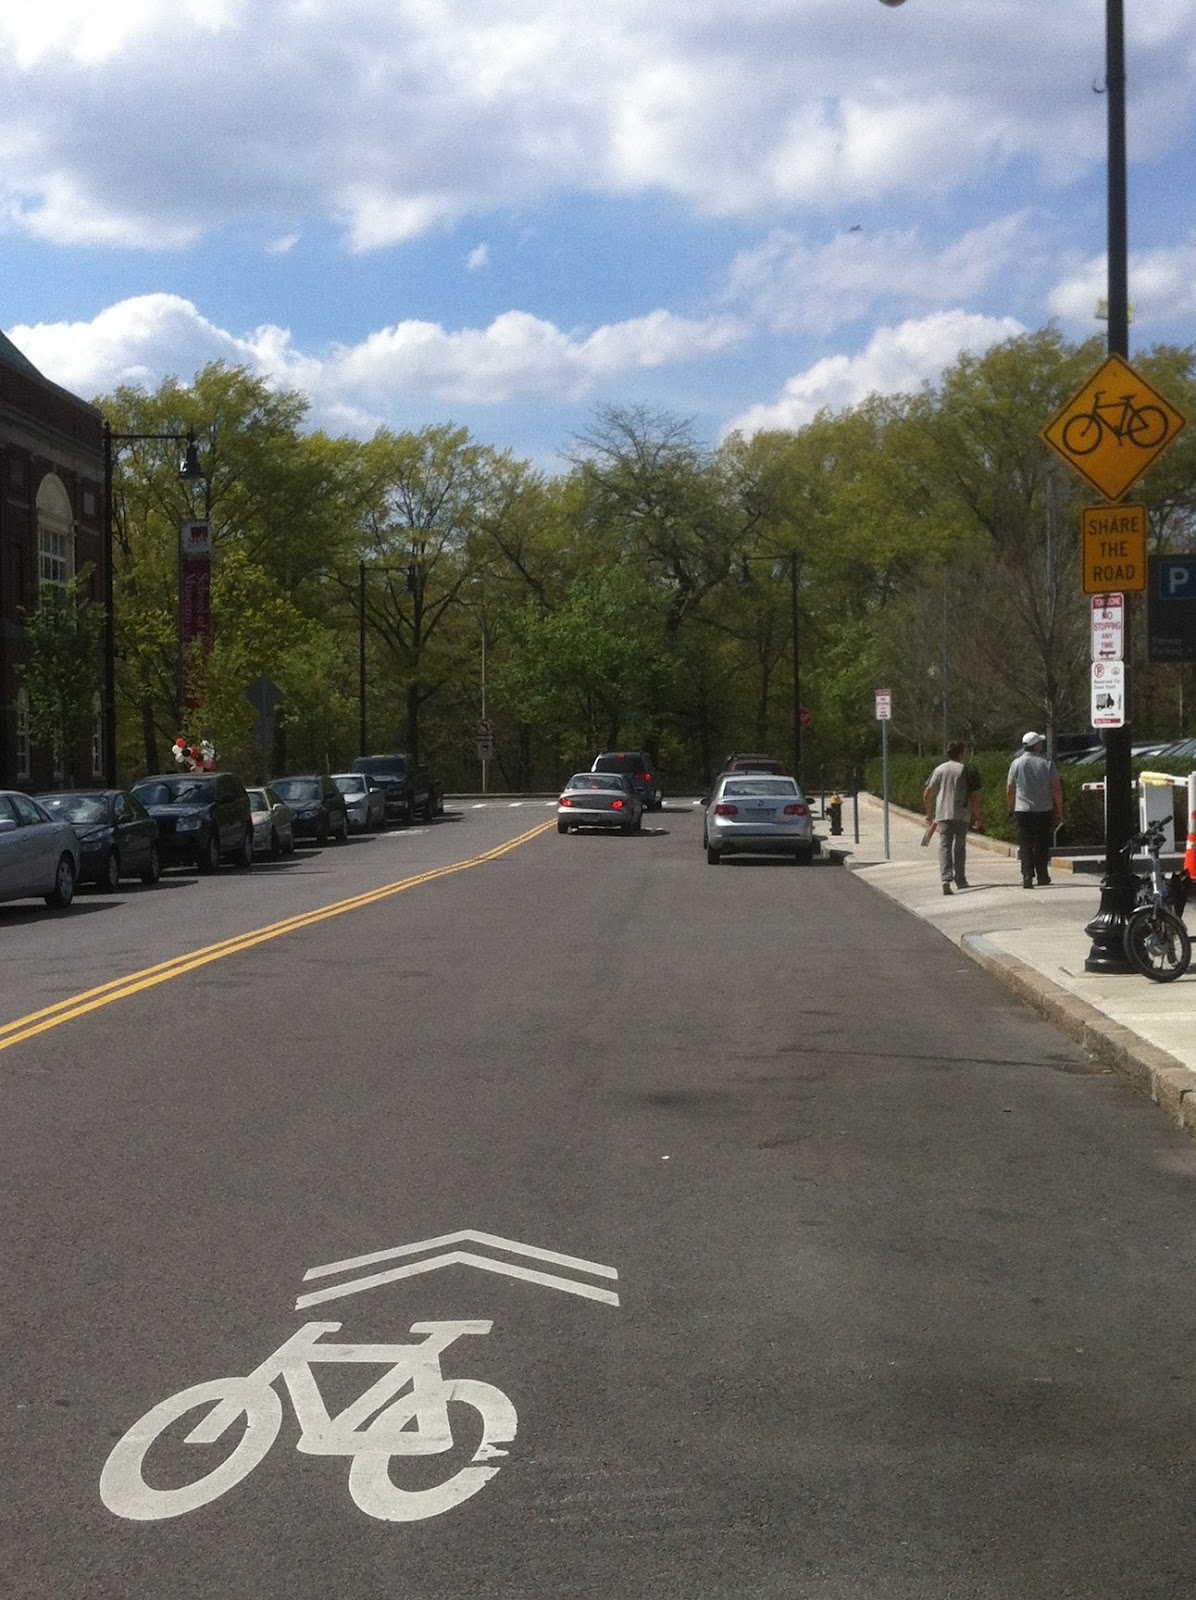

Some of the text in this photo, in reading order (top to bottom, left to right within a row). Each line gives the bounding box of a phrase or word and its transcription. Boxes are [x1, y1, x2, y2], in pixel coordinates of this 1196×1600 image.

[1088, 516, 1140, 536] SHARE
[1100, 541, 1128, 557] THE
[1093, 565, 1135, 582] ROAD
[1169, 567, 1190, 594] P
[1101, 611, 1113, 620] NO
